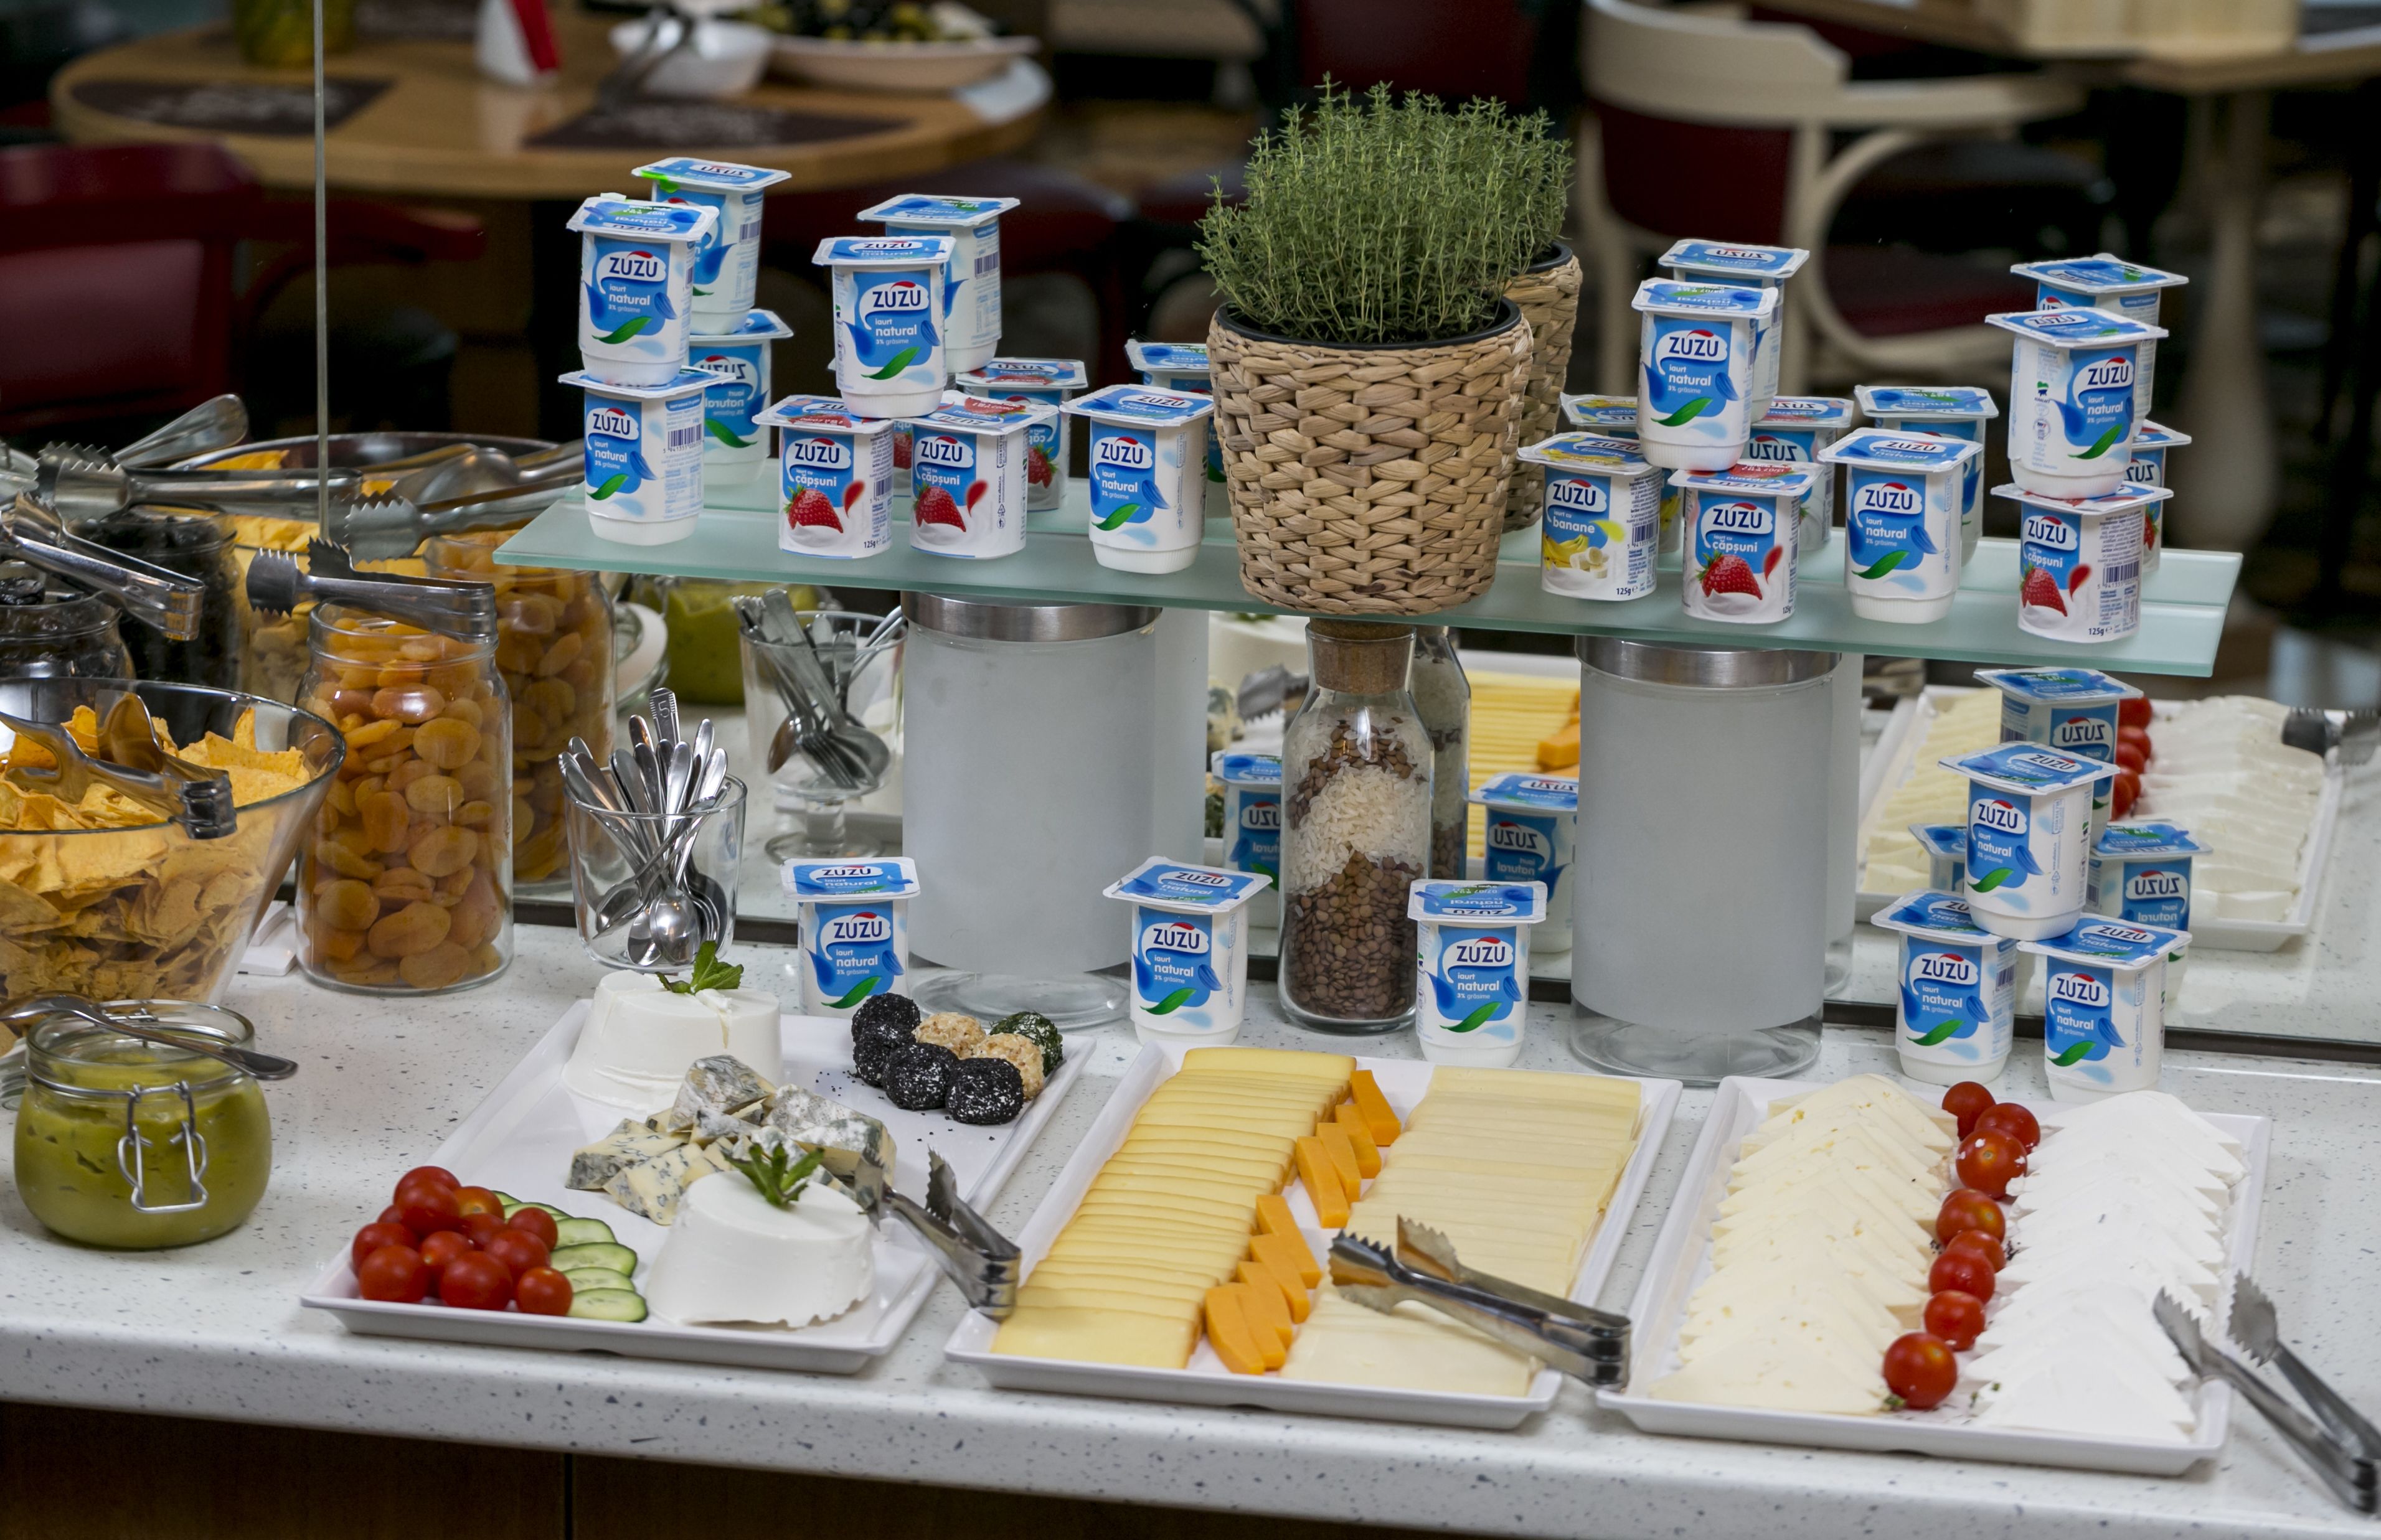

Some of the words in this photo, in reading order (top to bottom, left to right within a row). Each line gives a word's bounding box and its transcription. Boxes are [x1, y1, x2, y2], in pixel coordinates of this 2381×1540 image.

[609, 256, 658, 277] ZUZU
[610, 284, 626, 293] iaurt
[609, 293, 650, 306] natural
[872, 290, 921, 308] ZUZU
[876, 325, 917, 336] natural
[1669, 336, 1719, 357] ZUZU
[1669, 364, 1687, 373] iaurt
[2088, 365, 2129, 385] ZUZU
[1669, 373, 1711, 387] natural
[1138, 396, 1186, 406] ZUZU
[2088, 396, 2105, 404] iaurt
[2087, 403, 2123, 415] natural
[593, 413, 630, 435] ZUZU
[937, 415, 986, 425] ZUZU
[921, 440, 963, 462] ZUZU
[1590, 441, 1640, 451] ZUZU
[1887, 441, 1936, 451] ZUZU
[595, 449, 628, 462] natural
[795, 443, 839, 463] ZUZU
[1101, 443, 1143, 464] ZUZU
[1102, 470, 1116, 478] iaurt
[1102, 479, 1138, 492] natural
[1553, 484, 1596, 507] ZUZU
[1865, 489, 1913, 510] ZUZU
[1713, 509, 1762, 528] ZUZU
[1866, 517, 1882, 525] iaurt
[1553, 519, 1595, 534] banane
[1866, 527, 1907, 539] natural
[2028, 520, 2067, 545] ZUZU
[864, 540, 875, 548] 125g
[1616, 588, 1631, 596] 125g
[1783, 606, 1791, 614] 125g
[2088, 627, 2105, 636] 125g
[2029, 754, 2075, 769] ZUZU
[1978, 804, 2018, 829] ZUZU
[1978, 831, 1991, 841] iaurt
[1978, 841, 2012, 857] natural
[1175, 872, 1225, 885] ZUZU
[1161, 885, 1214, 894] natural
[1946, 901, 1969, 911] ZU
[834, 921, 882, 939] ZUZU
[2097, 926, 2147, 940] ZUZU
[1153, 928, 1200, 950] ZUZU
[2082, 939, 2133, 951] natural
[1154, 955, 1171, 963] iaurt
[1456, 946, 1506, 962] ZUZU
[836, 955, 878, 967] natural
[1154, 964, 1194, 977] natural
[1921, 959, 1969, 981] ZUZU
[1458, 980, 1499, 991] natural
[1923, 985, 1939, 993] iaurt
[2057, 978, 2100, 1002] ZUZU
[1923, 995, 1963, 1008] natural
[2057, 1006, 2072, 1015] iaurt
[2057, 1015, 2094, 1031] natural
